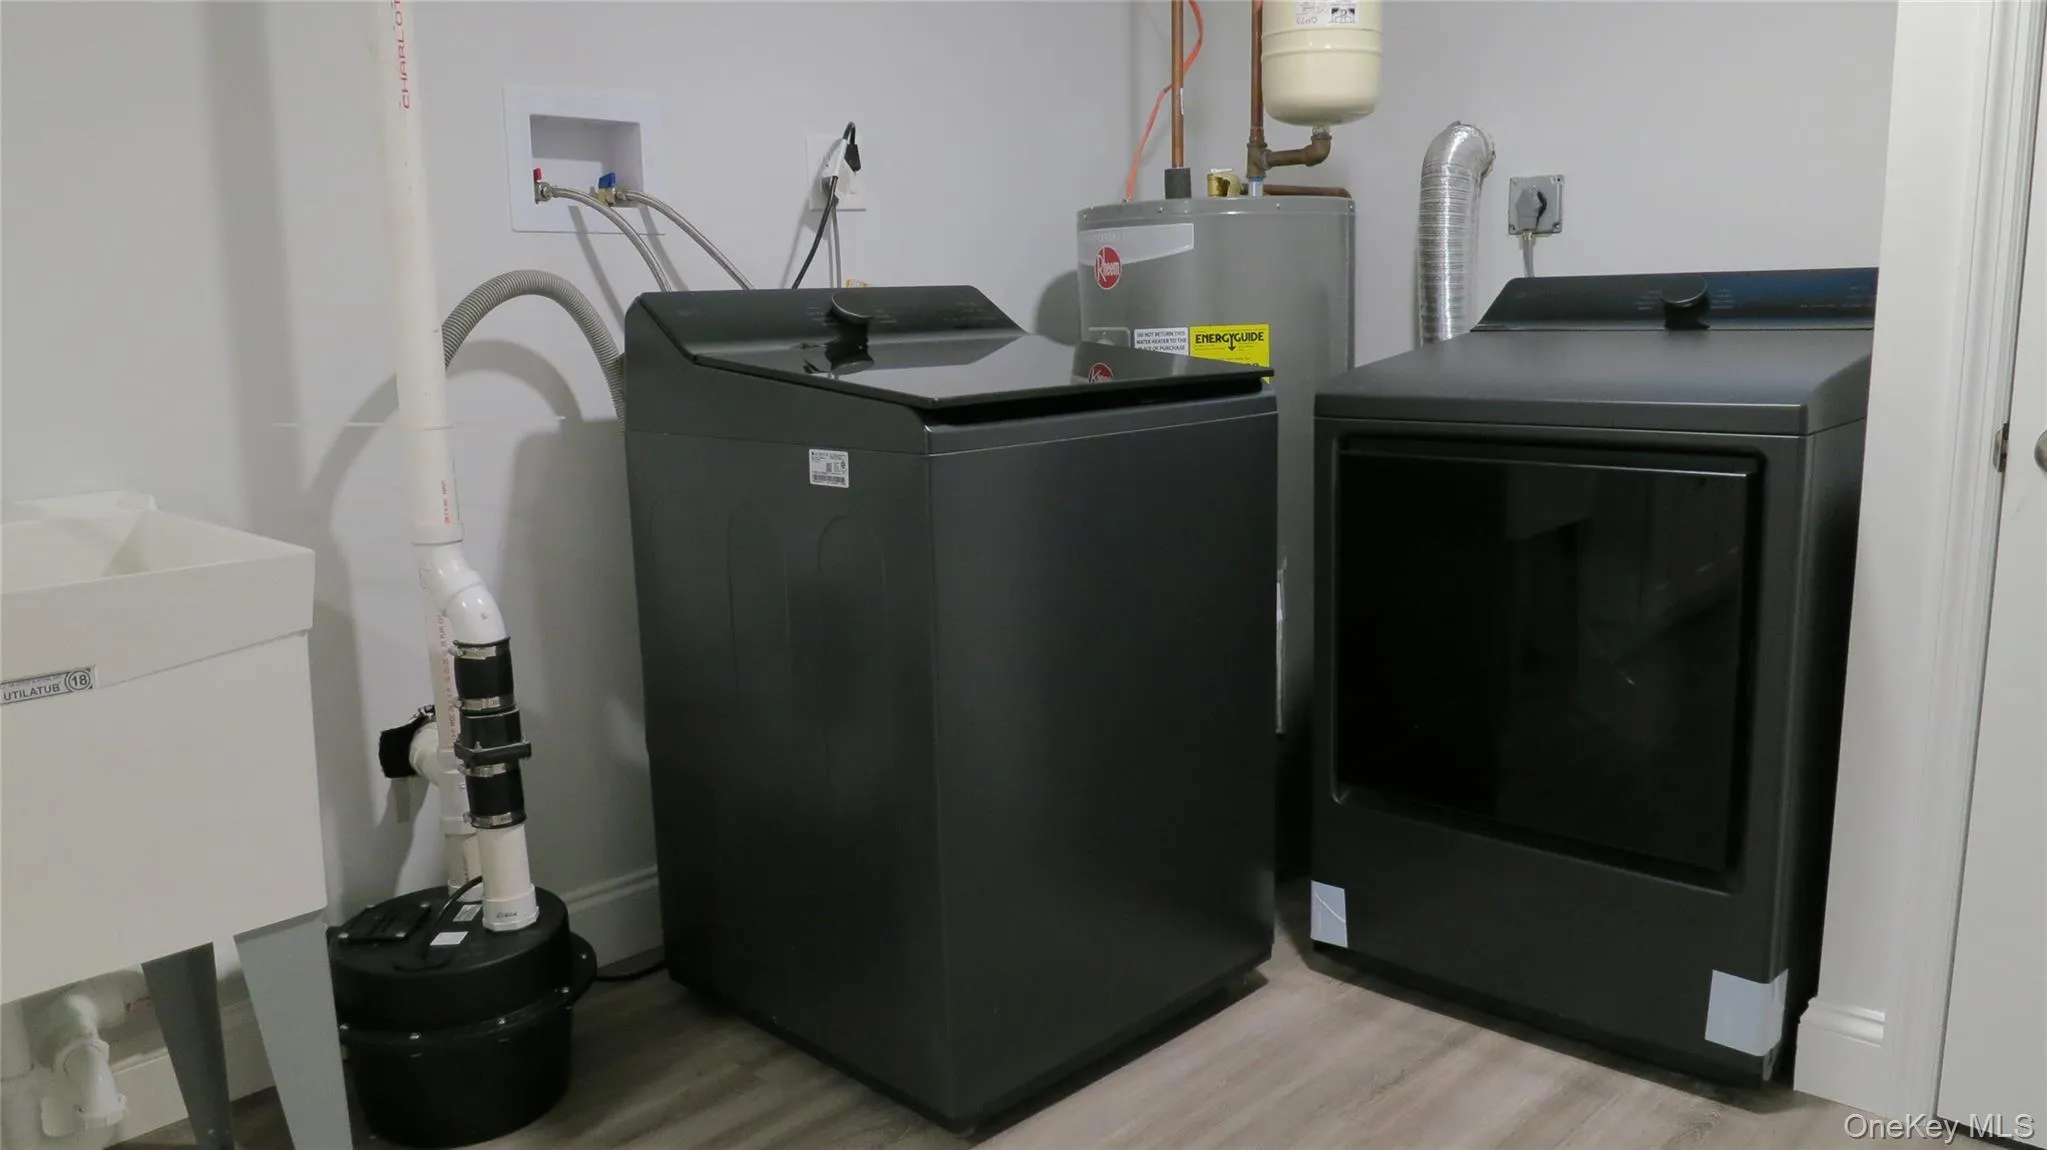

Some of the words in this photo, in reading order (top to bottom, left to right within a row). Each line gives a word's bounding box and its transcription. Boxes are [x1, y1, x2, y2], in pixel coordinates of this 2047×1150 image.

[1097, 248, 1120, 282] Rheem
[4, 683, 60, 700] UTILATUB
[72, 674, 88, 687] 18
